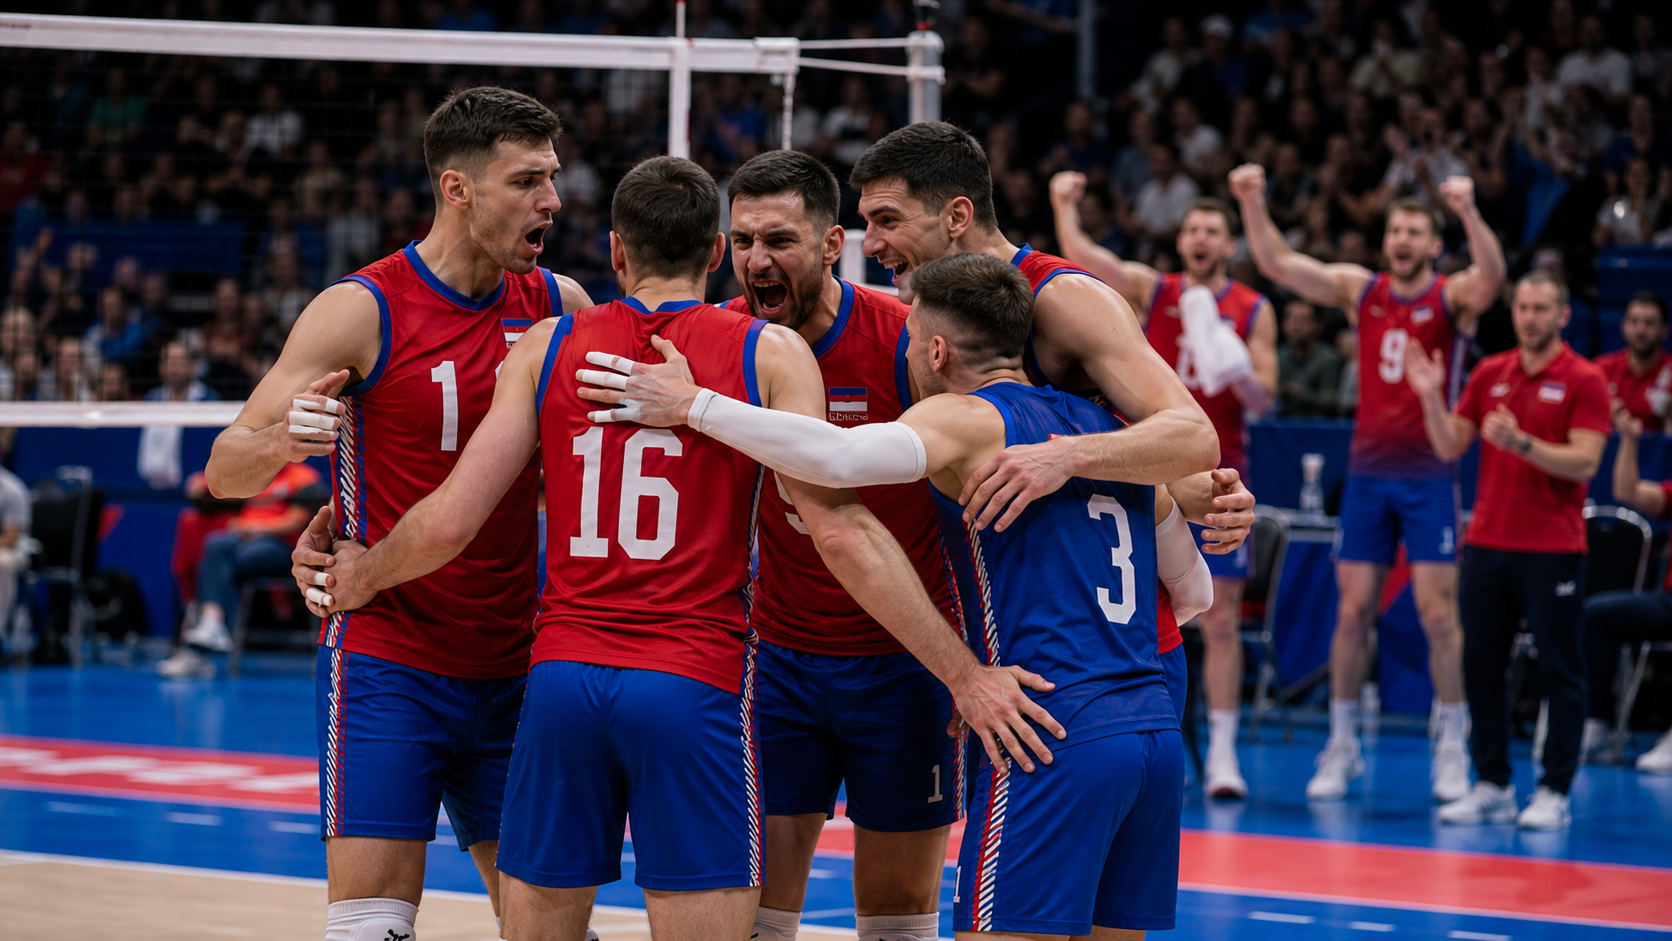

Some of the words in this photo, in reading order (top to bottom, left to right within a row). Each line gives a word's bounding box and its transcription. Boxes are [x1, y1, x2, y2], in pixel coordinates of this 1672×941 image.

[1379, 328, 1408, 384] 9
[570, 426, 683, 560] 16
[1087, 493, 1136, 625] 3
[928, 764, 943, 803] 1
[953, 866, 961, 903] 1
